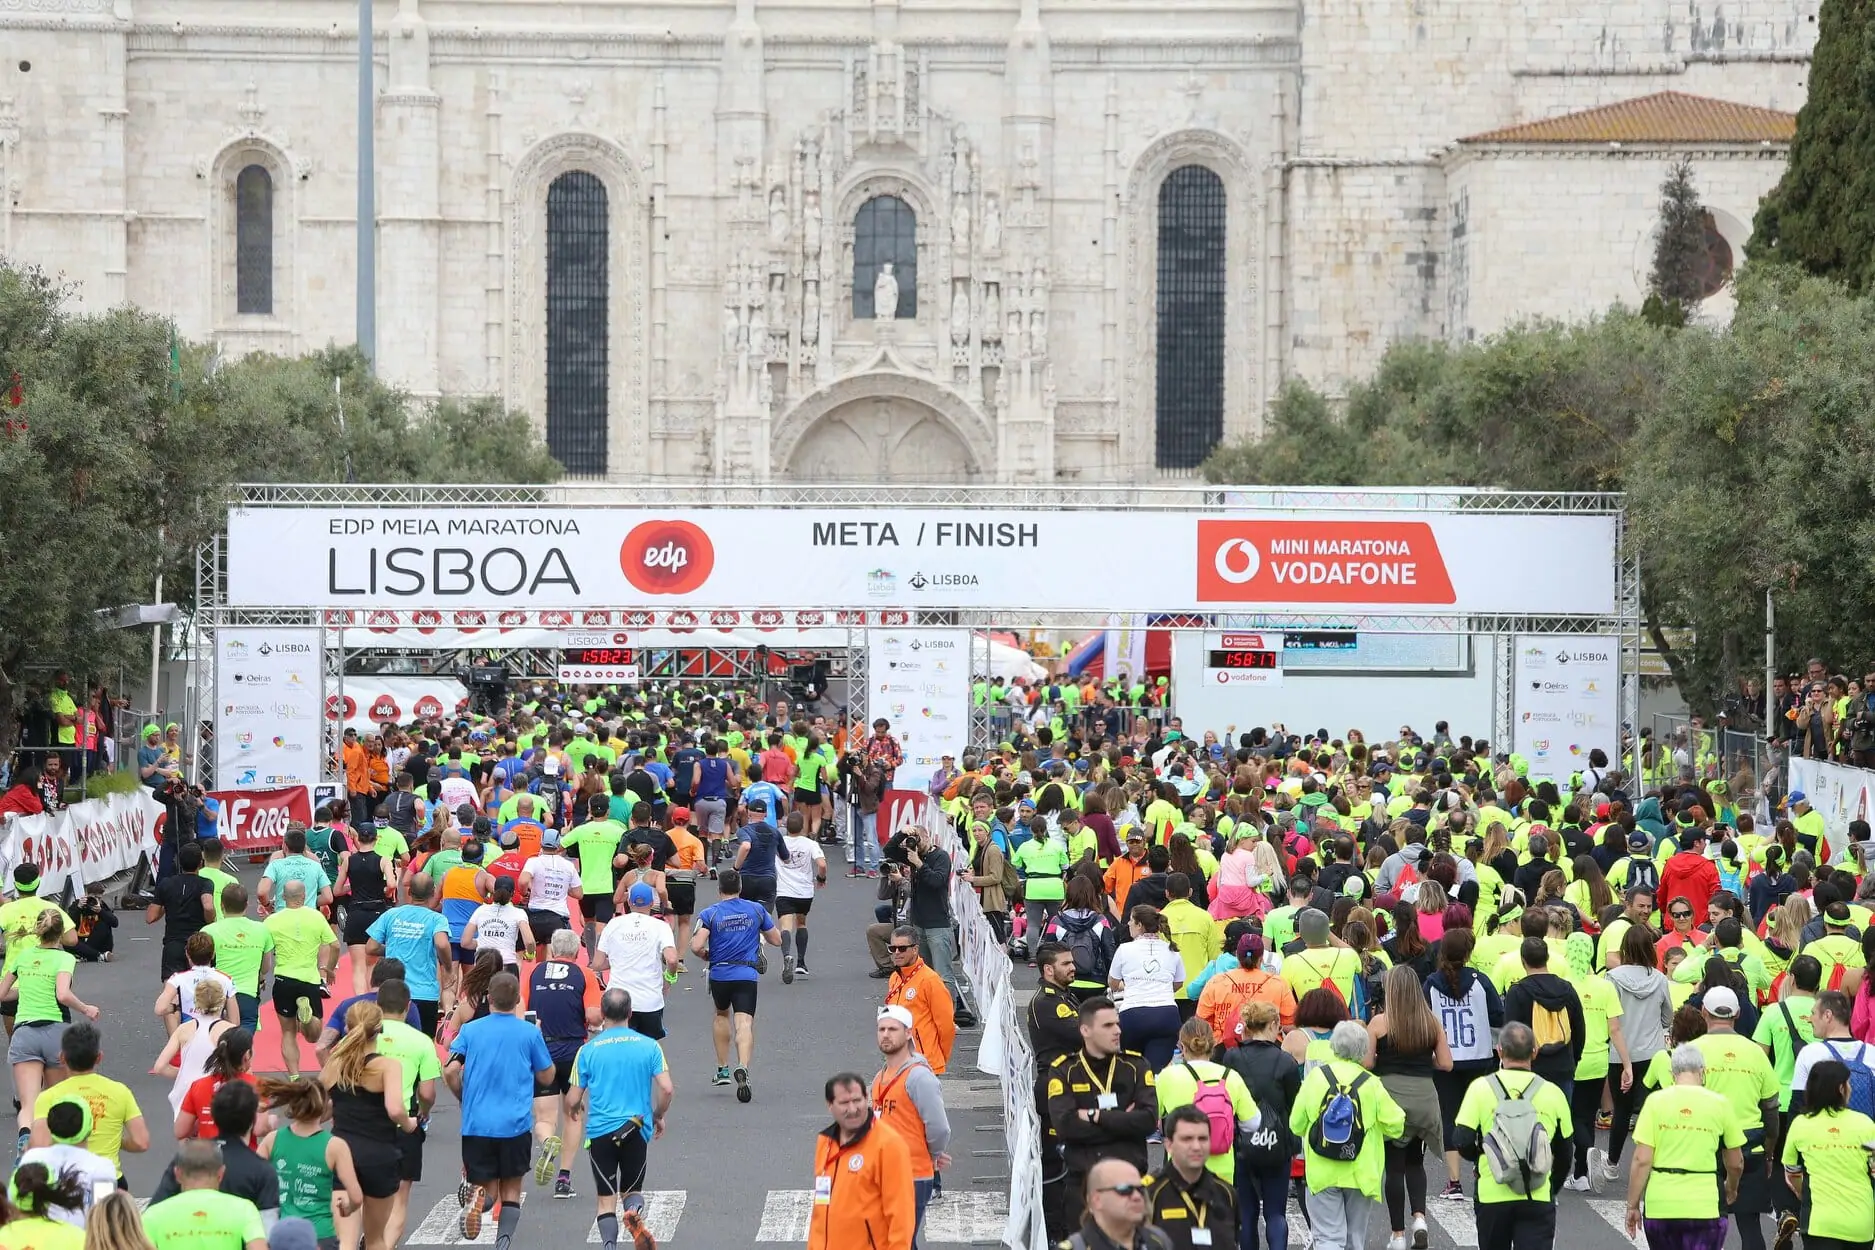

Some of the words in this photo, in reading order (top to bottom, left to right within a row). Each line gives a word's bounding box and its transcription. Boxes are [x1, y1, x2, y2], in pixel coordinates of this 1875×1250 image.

[329, 518, 374, 535] EDP
[382, 518, 441, 535] MEIA
[447, 518, 581, 535] MARATONA
[812, 522, 900, 546] META
[916, 522, 926, 546] /
[936, 523, 1038, 547] FINISH
[1270, 539, 1308, 555] MINI
[1313, 540, 1411, 556] MARATONA
[643, 541, 689, 573] edp
[329, 547, 581, 596] LISBOA
[1270, 562, 1417, 585] VODAFONE
[932, 574, 980, 586] LISBOA
[567, 637, 607, 646] LISBOA
[924, 640, 955, 648] LISBOA
[275, 644, 310, 653] LISBOA
[582, 650, 632, 664] 1:58:23
[1226, 652, 1275, 667] 1:58:17
[1573, 653, 1608, 661] LISBOA
[246, 674, 272, 682] Oeiras
[1231, 673, 1267, 681] vodafone
[1544, 681, 1569, 689] Oeiras
[376, 704, 393, 717] edp
[420, 704, 437, 717] edp
[1231, 982, 1263, 993] ANETE
[1250, 1128, 1278, 1151] edp
